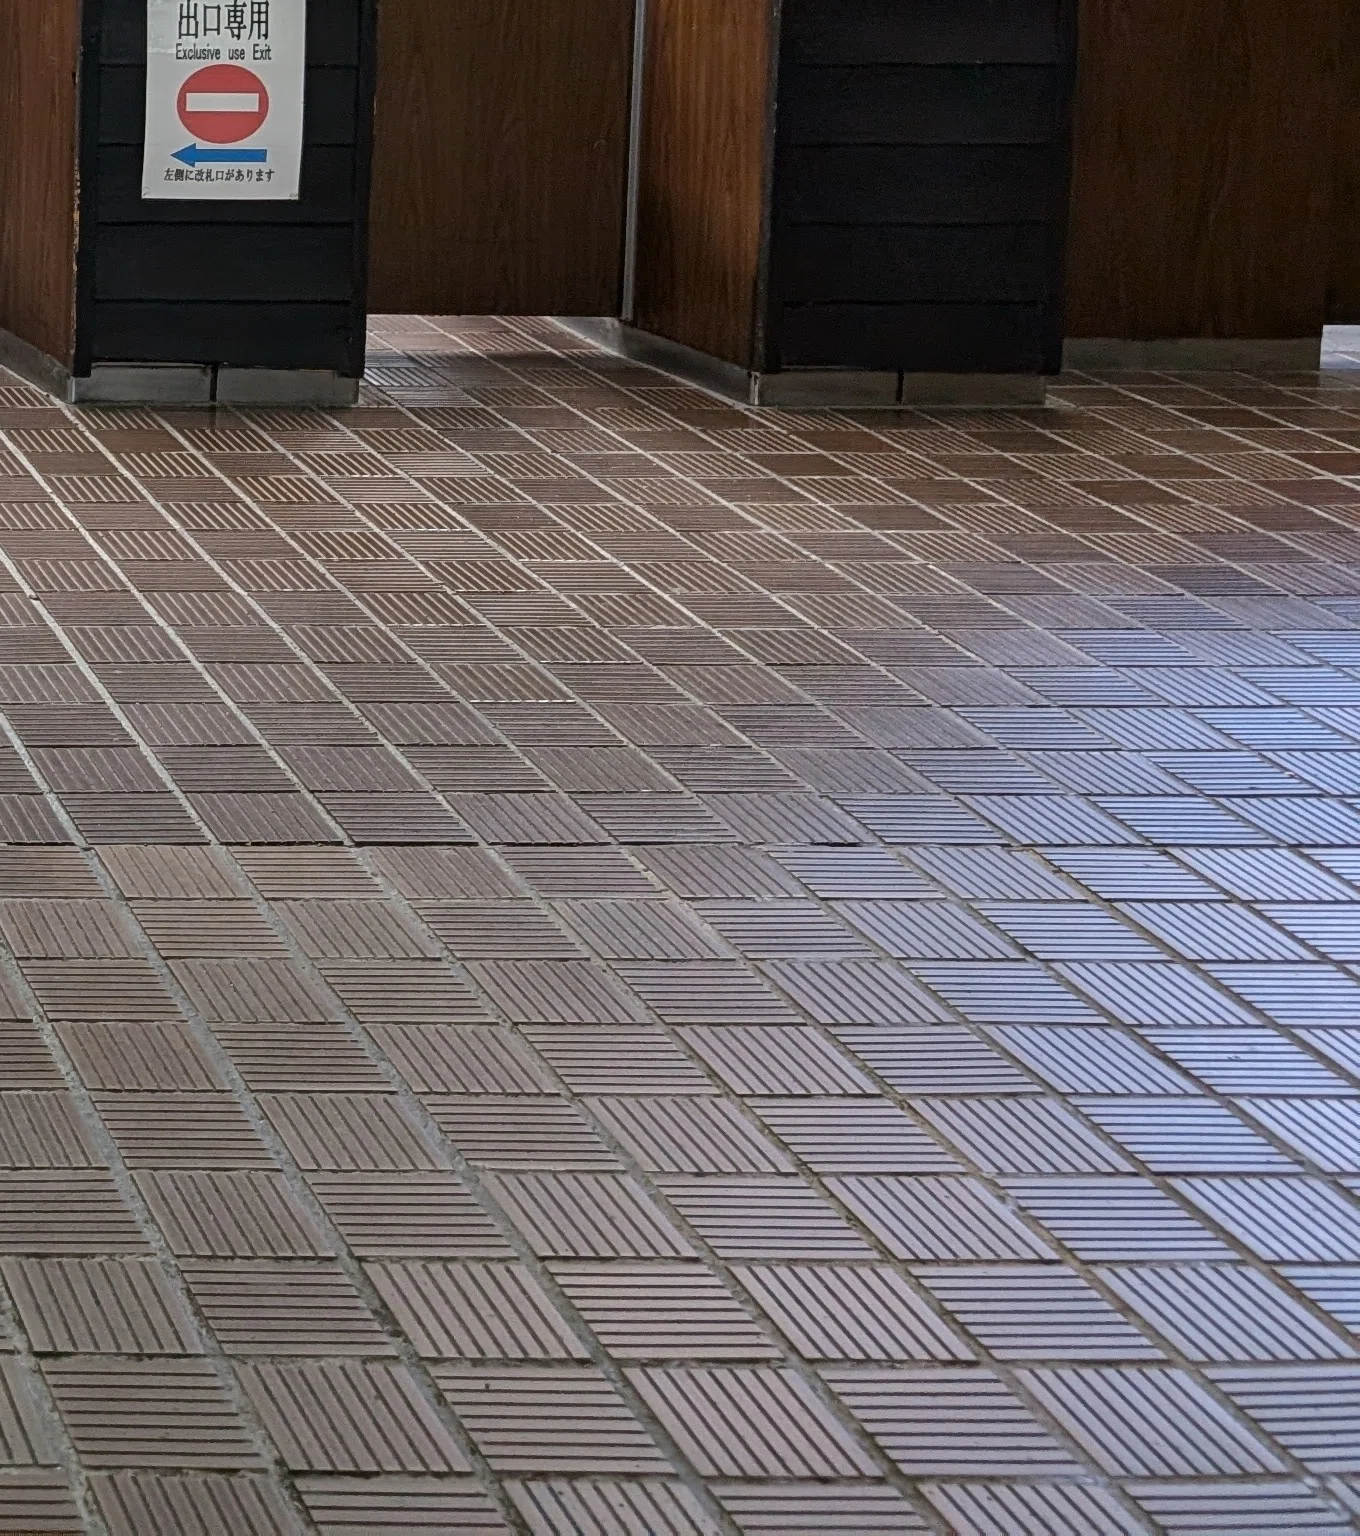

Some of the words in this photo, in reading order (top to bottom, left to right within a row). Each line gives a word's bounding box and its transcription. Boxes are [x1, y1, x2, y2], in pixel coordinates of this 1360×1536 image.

[176, 43, 220, 60] Exclusive
[228, 47, 245, 60] use
[253, 43, 271, 61] Exit
[164, 168, 274, 182] 左側に改札口があります
